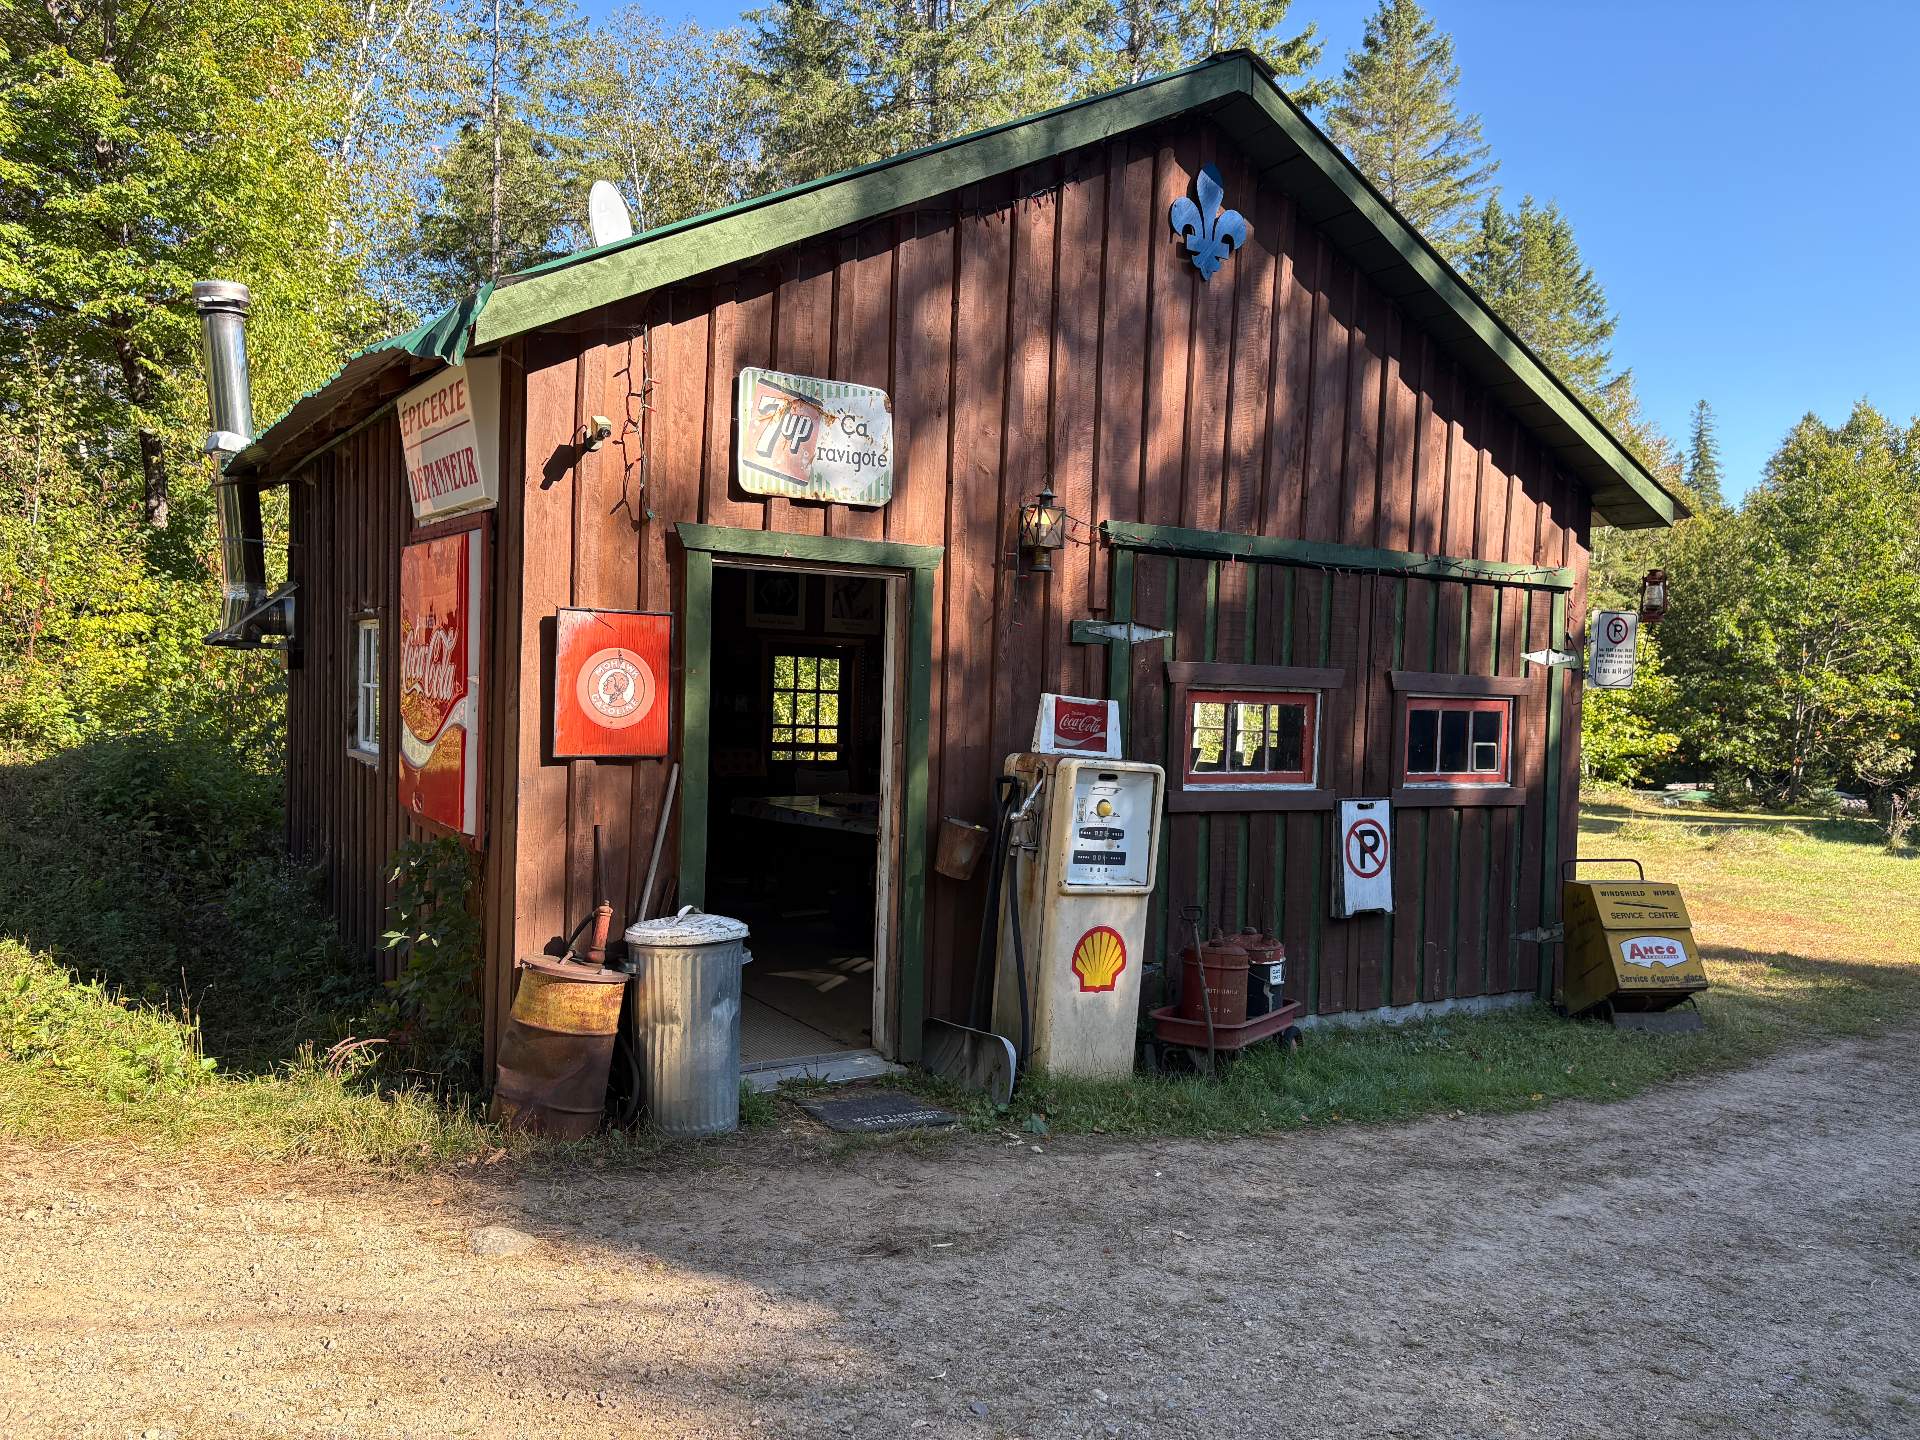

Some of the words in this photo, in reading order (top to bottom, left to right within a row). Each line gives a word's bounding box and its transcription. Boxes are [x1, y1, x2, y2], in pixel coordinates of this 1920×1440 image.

[401, 378, 466, 438] ÉPICERIE
[817, 446, 888, 473] ravigote
[410, 446, 479, 504] DÉPANNEUR
[1613, 624, 1623, 638] P
[595, 660, 640, 680] MOHAWK
[592, 693, 639, 715] GASOLINE
[1359, 829, 1381, 869] P
[1611, 911, 1645, 919] SERVICE
[1648, 911, 1680, 919] CENTRE
[1619, 974, 1649, 983] Service
